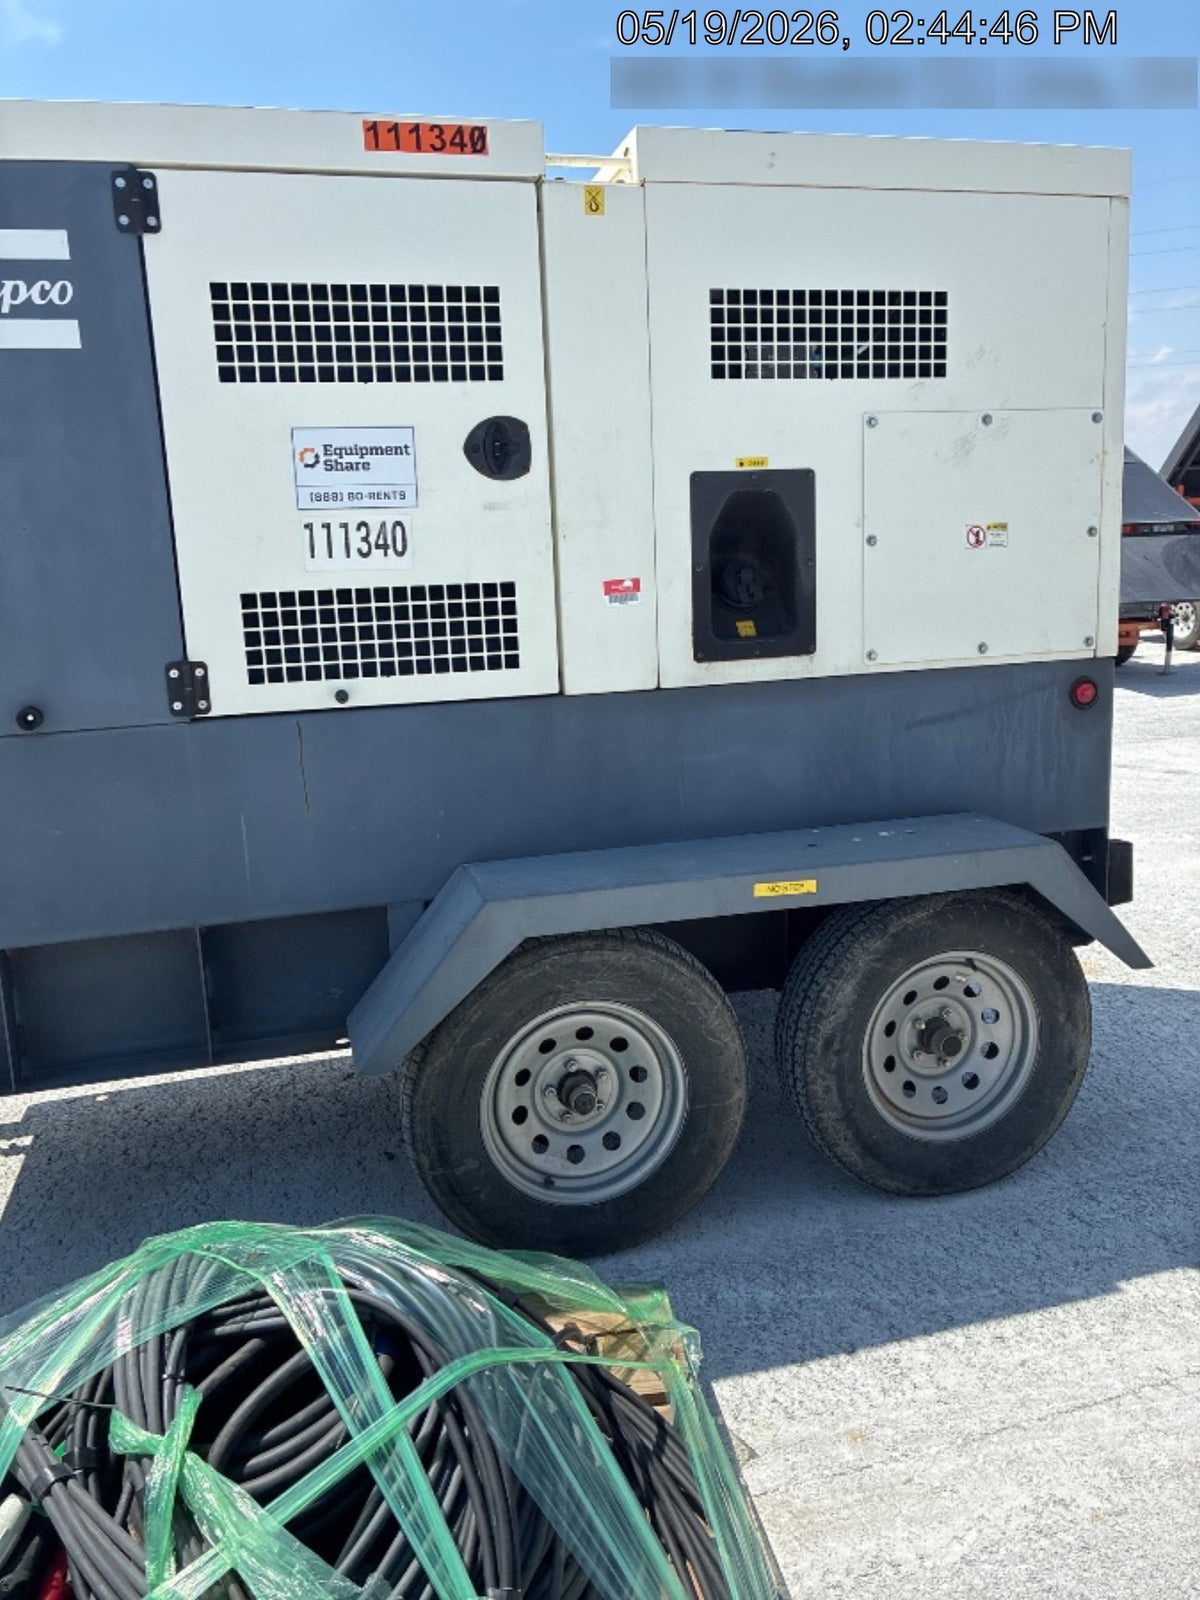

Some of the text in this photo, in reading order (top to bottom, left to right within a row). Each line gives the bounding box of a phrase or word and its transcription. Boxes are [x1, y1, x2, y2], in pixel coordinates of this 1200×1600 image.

[366, 121, 487, 153] 111340
[0, 280, 73, 314] pco
[322, 443, 411, 459] Equipment
[323, 459, 371, 472] Share
[303, 520, 408, 559] 111340
